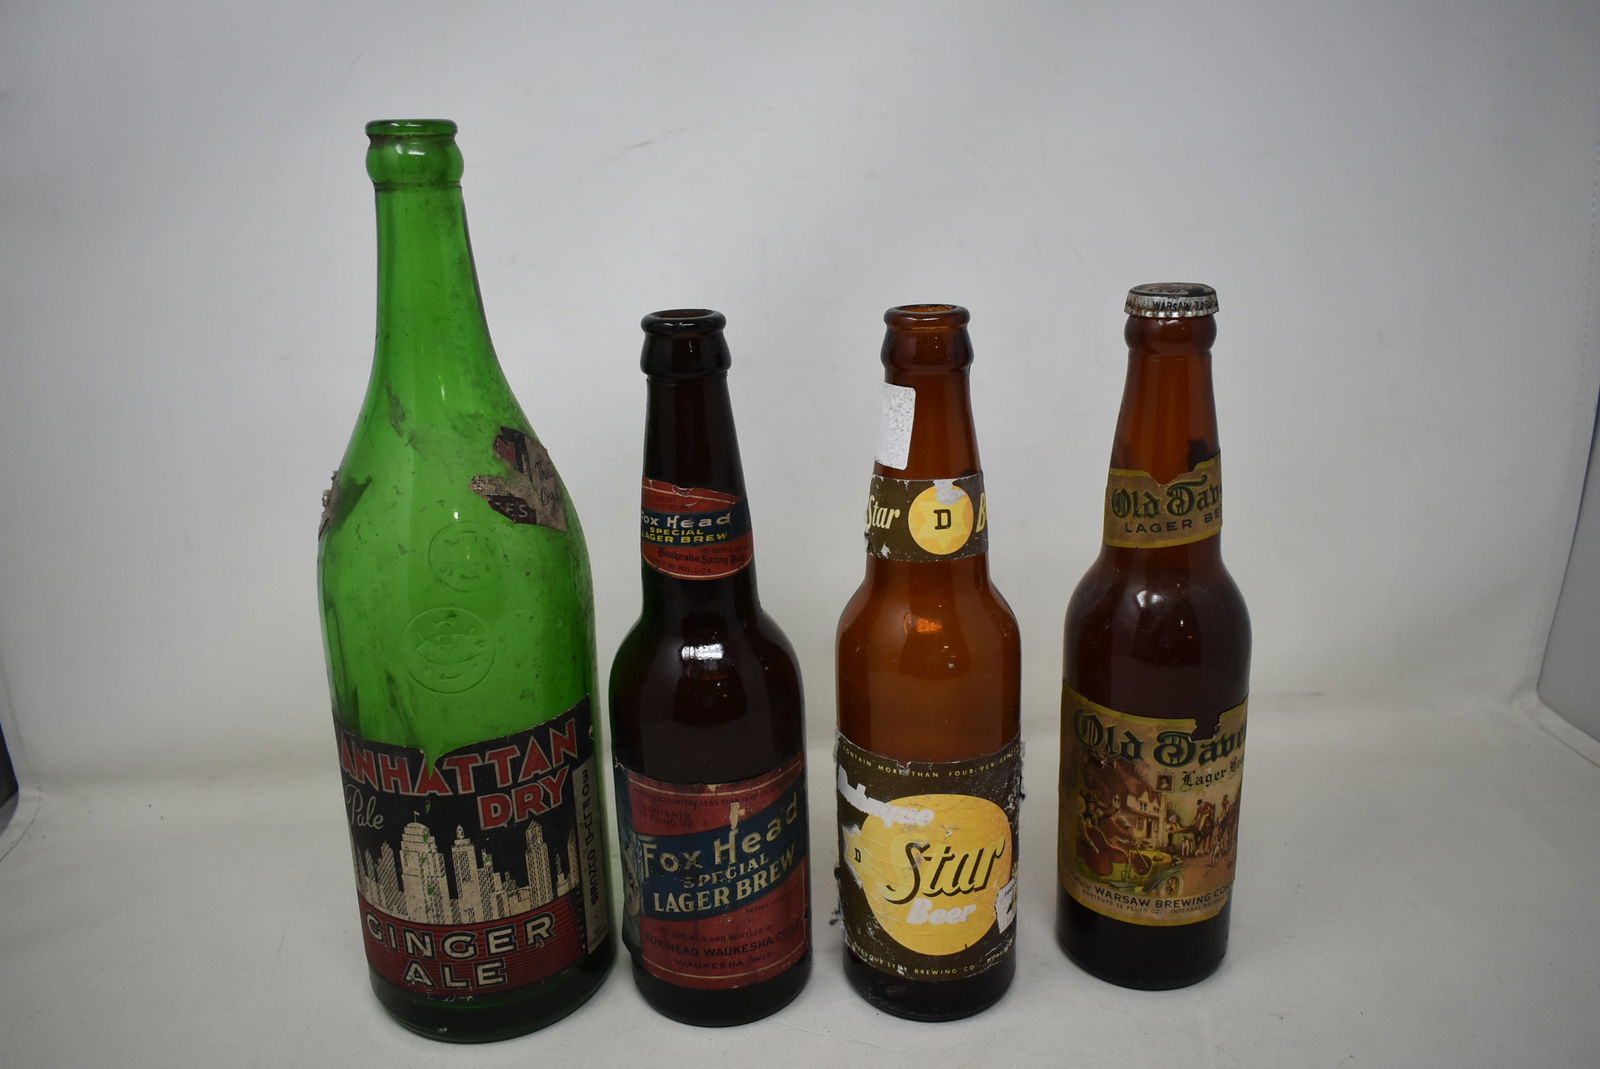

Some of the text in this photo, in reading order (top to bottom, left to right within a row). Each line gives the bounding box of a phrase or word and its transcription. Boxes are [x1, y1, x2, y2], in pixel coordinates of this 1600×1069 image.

[866, 494, 900, 530] Star
[1112, 487, 1161, 518] Old
[649, 526, 705, 537] SPECIAL
[666, 512, 731, 530] Head
[933, 508, 952, 531] D
[1125, 519, 1193, 534] LAGER
[680, 532, 728, 544] BREW
[1073, 708, 1145, 763] Old
[912, 771, 939, 779] THAN
[948, 767, 974, 777] FOUR
[1180, 768, 1227, 792] Lager
[345, 783, 385, 830] Pale
[476, 765, 570, 831] DRY
[641, 791, 799, 878] Fox Head
[854, 846, 862, 864] D
[653, 844, 795, 913] LAGER BREW
[684, 852, 770, 889] SPECIAL
[883, 837, 1007, 905] Star
[1094, 884, 1151, 907] WARSAW
[1155, 892, 1211, 909] BREWING
[906, 897, 977, 926] Beer
[365, 911, 554, 962] GINGER
[704, 935, 774, 957] WAUKESHA
[403, 959, 506, 988] ALE
[914, 967, 958, 976] BREWING
